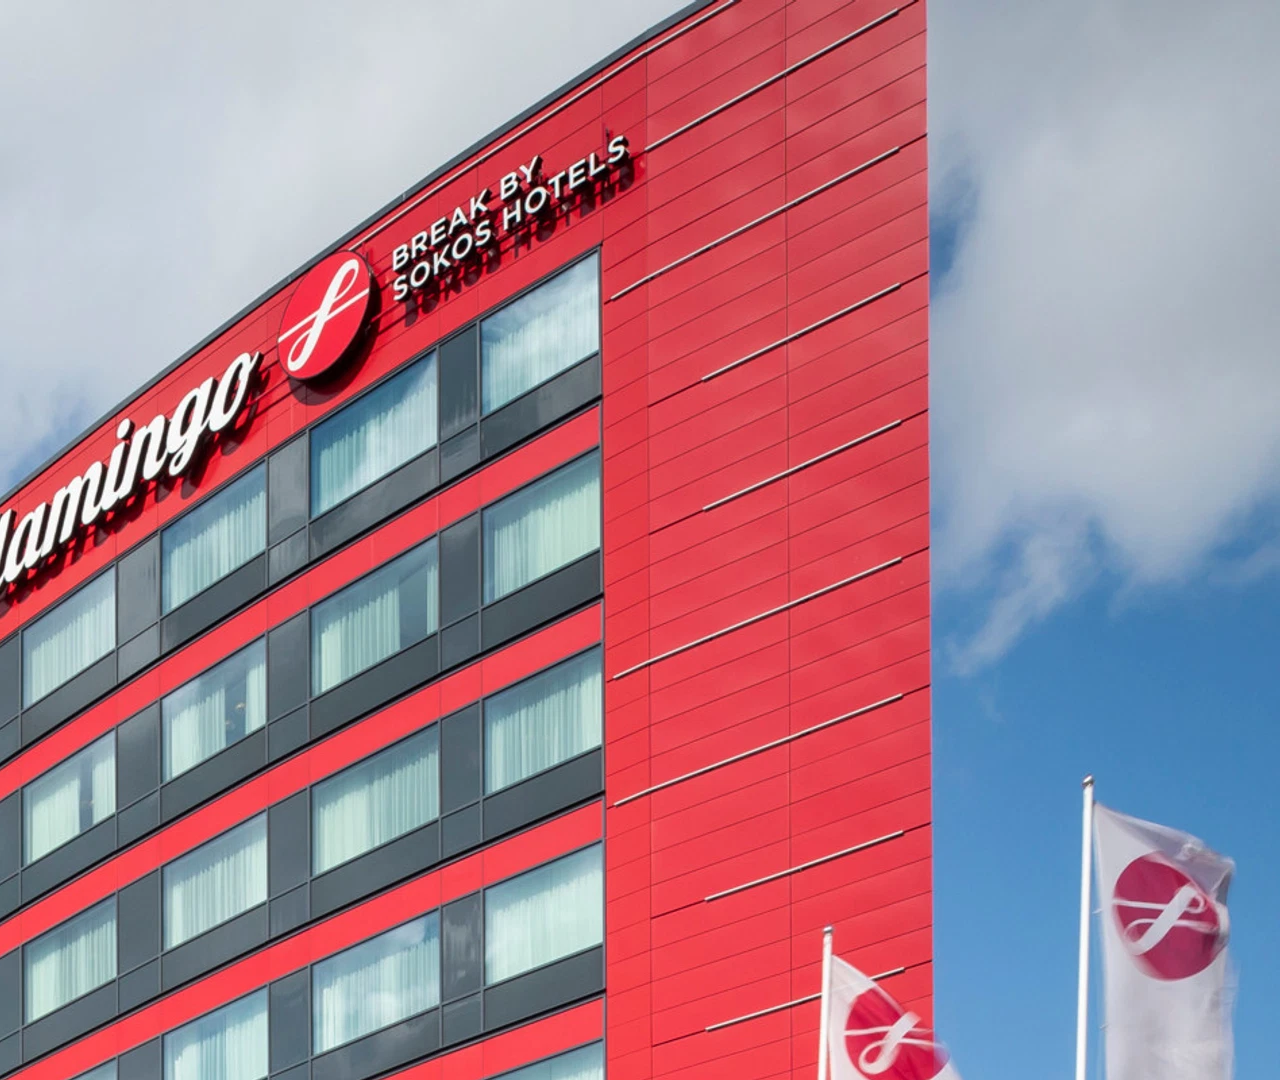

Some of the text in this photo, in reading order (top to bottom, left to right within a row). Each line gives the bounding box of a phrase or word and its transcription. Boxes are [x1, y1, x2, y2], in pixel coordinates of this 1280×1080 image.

[392, 155, 539, 271] BREAK BY
[393, 135, 626, 300] SOKOS HOTELS
